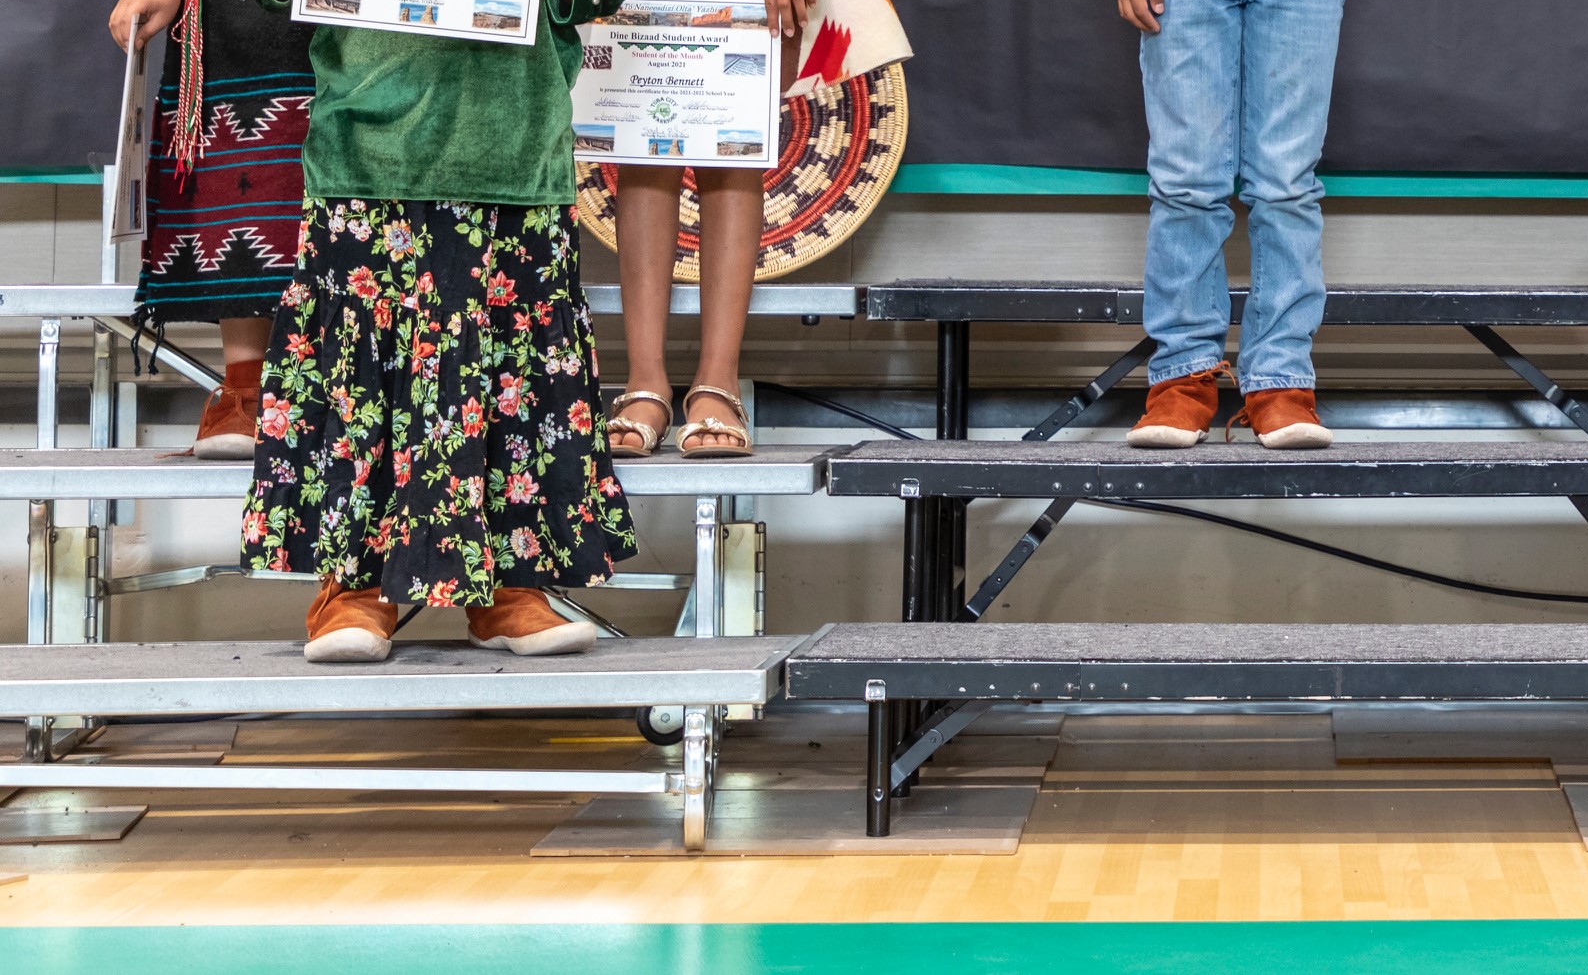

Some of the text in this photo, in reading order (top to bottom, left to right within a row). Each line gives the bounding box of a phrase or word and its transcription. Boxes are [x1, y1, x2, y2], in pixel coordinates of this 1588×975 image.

[610, 31, 729, 43] Dine Bizaad Student Award
[630, 75, 704, 88] Peyton Bennett
[650, 97, 665, 108] TUBA
[665, 97, 679, 107] CITY
